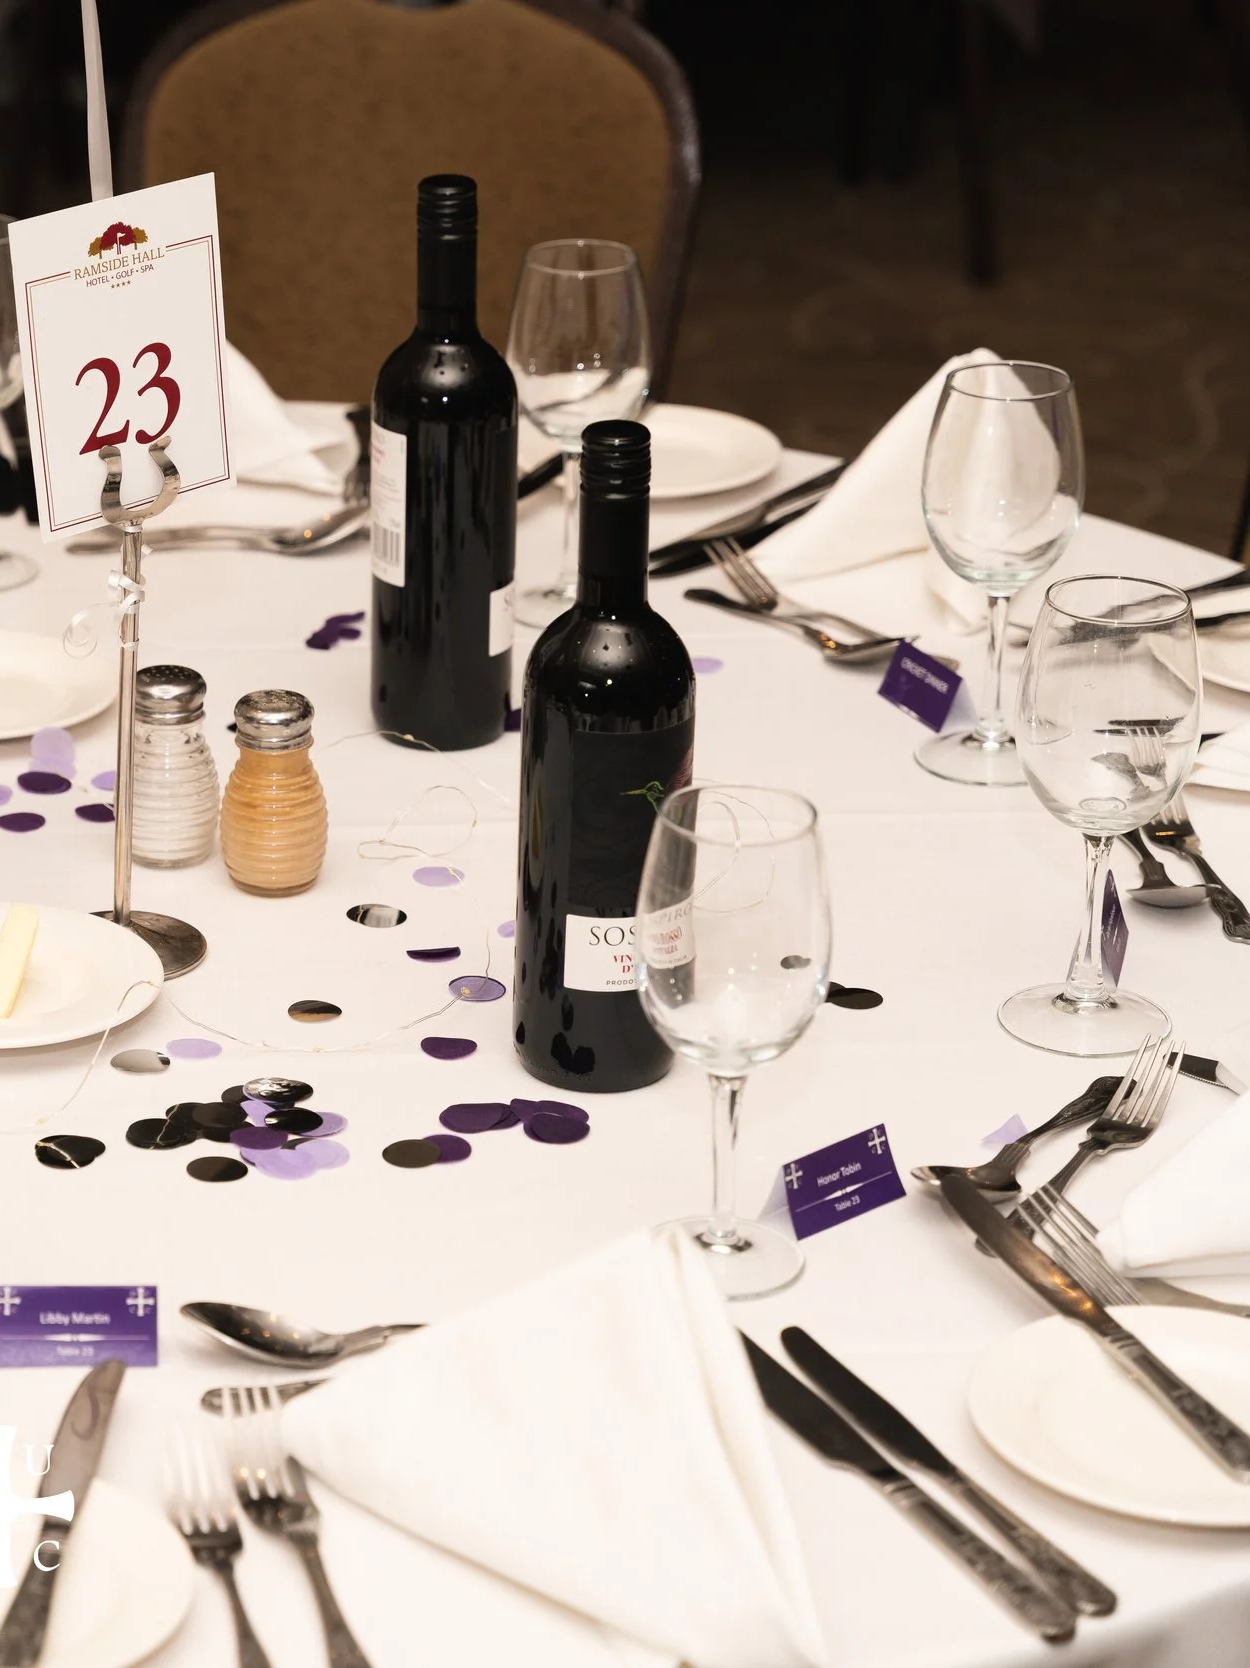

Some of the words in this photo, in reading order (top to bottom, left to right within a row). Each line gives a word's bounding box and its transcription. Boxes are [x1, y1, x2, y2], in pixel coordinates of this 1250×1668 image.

[73, 255, 129, 280] RAMSIDE
[131, 247, 165, 265] HALL
[86, 275, 110, 288] HOTEL
[115, 268, 135, 280] GOLF
[140, 263, 155, 274] SPA
[75, 342, 181, 456] 23
[834, 1199, 852, 1212] Table
[851, 1195, 861, 1206] 23
[71, 1311, 111, 1325] Martin
